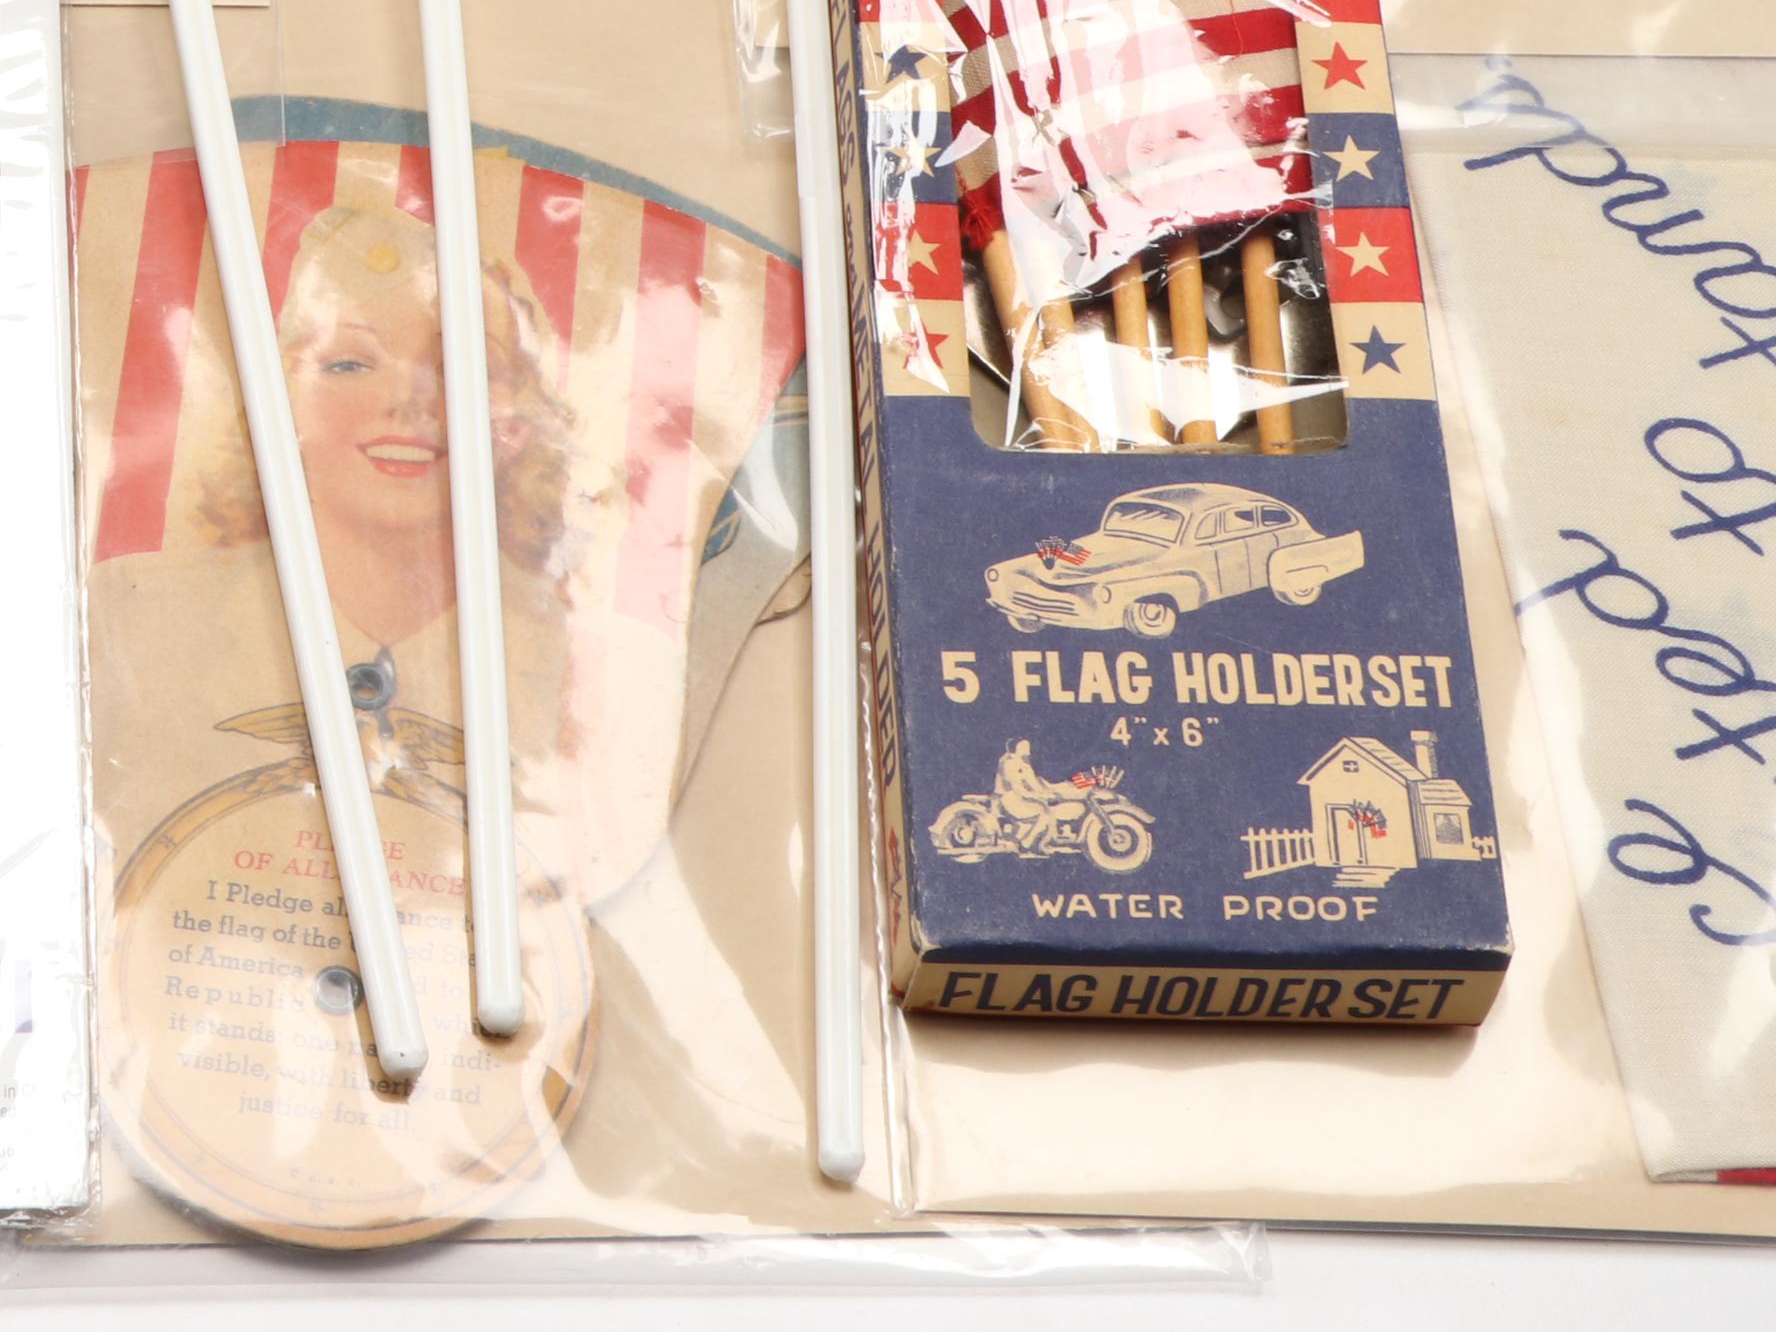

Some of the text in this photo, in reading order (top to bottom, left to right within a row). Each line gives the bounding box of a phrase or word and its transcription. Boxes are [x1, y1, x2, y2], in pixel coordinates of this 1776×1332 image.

[845, 203, 858, 302] and
[850, 280, 876, 517] METAL
[866, 521, 897, 796] HOLDER
[941, 651, 981, 705] 5
[1011, 650, 1154, 704] FLAG
[296, 830, 406, 861] PLE
[234, 850, 466, 897] OF ALLANCE
[207, 879, 219, 901] I
[225, 882, 313, 915] Pledge
[322, 895, 454, 931] alance
[1030, 893, 1380, 923] WATER PROOF
[173, 910, 212, 933] the
[217, 914, 267, 943] flag
[273, 923, 298, 945] of
[303, 927, 342, 951] the
[168, 945, 306, 979] of America
[938, 970, 1098, 1015] FLAG
[168, 1011, 189, 1031] it
